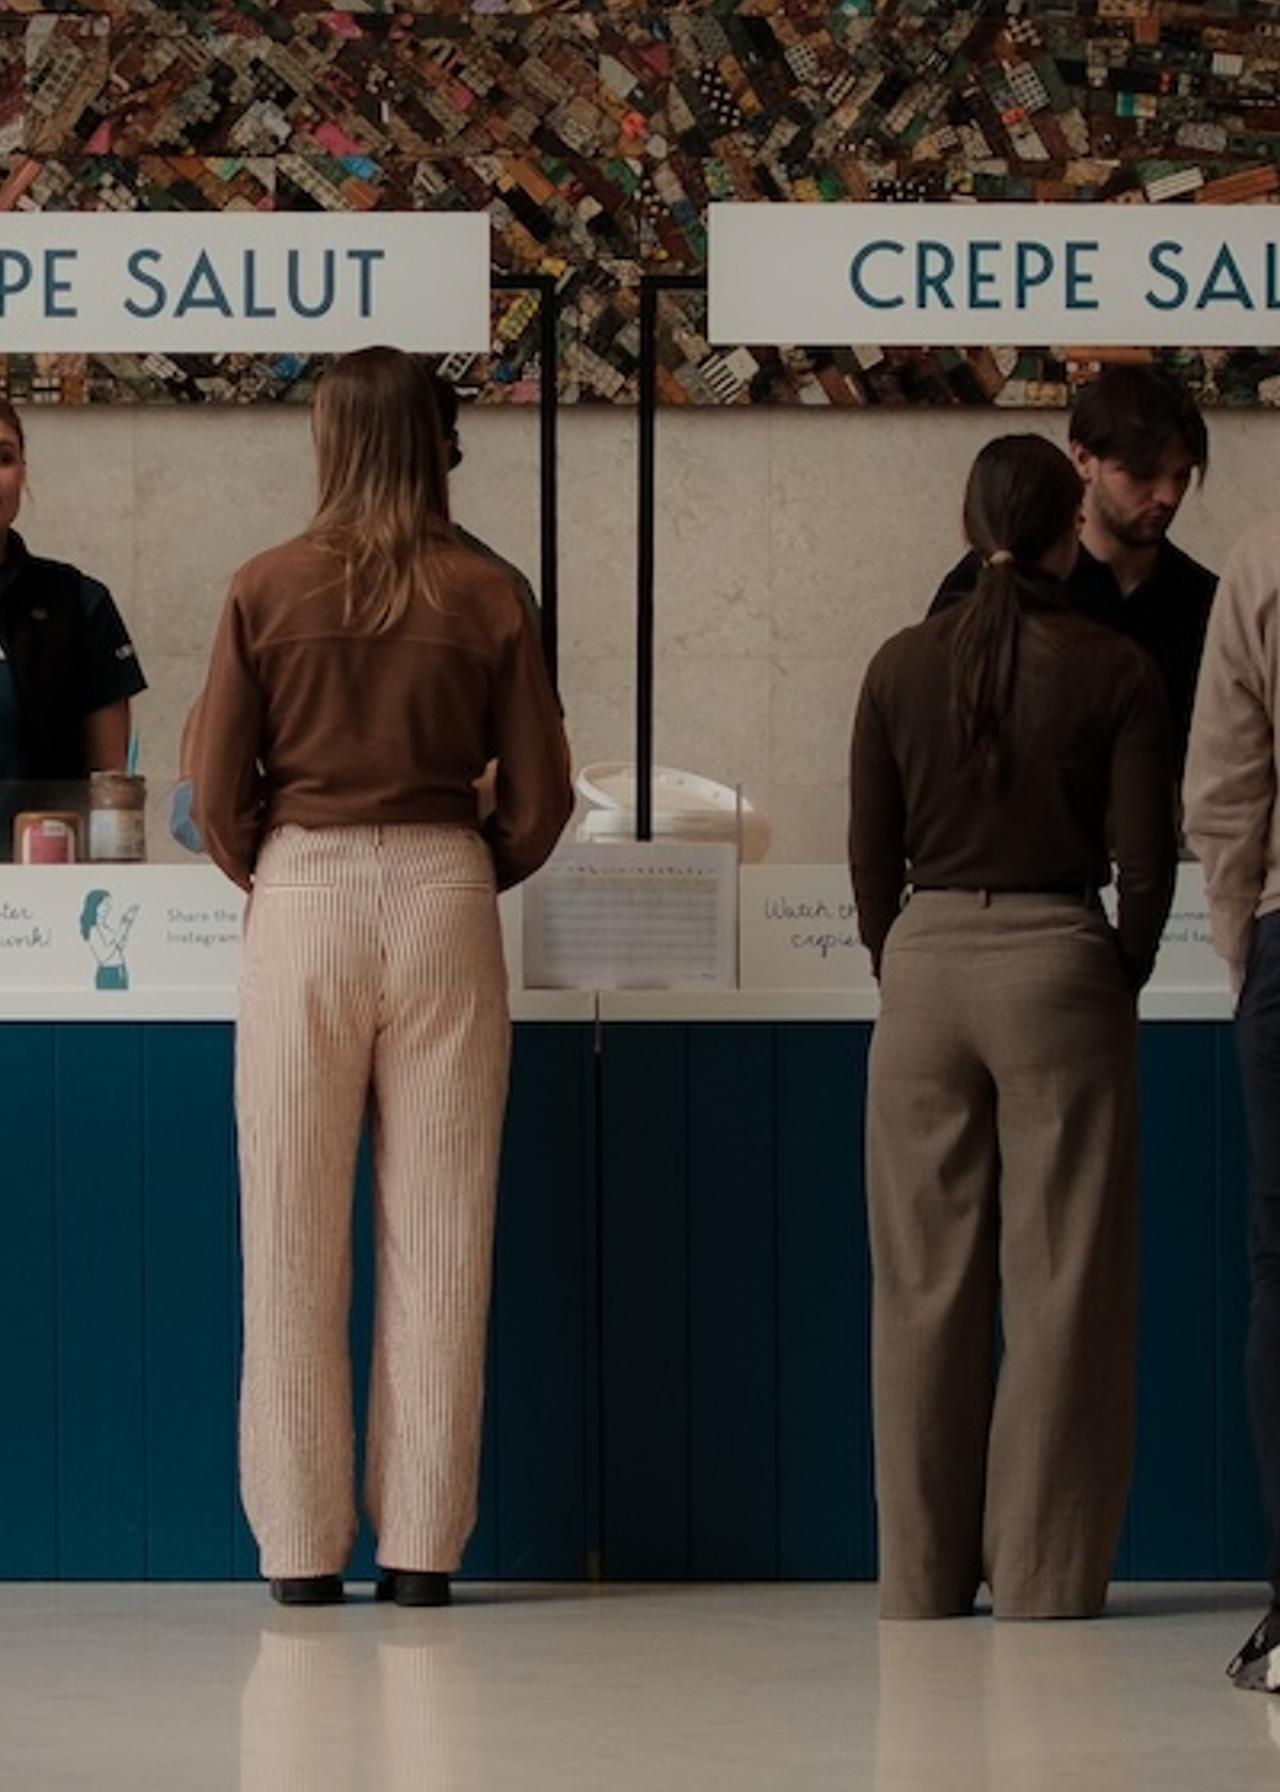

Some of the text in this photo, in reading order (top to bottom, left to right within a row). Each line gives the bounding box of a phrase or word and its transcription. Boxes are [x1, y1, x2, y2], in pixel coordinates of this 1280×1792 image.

[123, 248, 386, 319] SALUT
[849, 239, 1100, 311] CREPE
[166, 909, 210, 923] Share
[764, 897, 834, 921] Watch
[166, 930, 239, 950] Instagram
